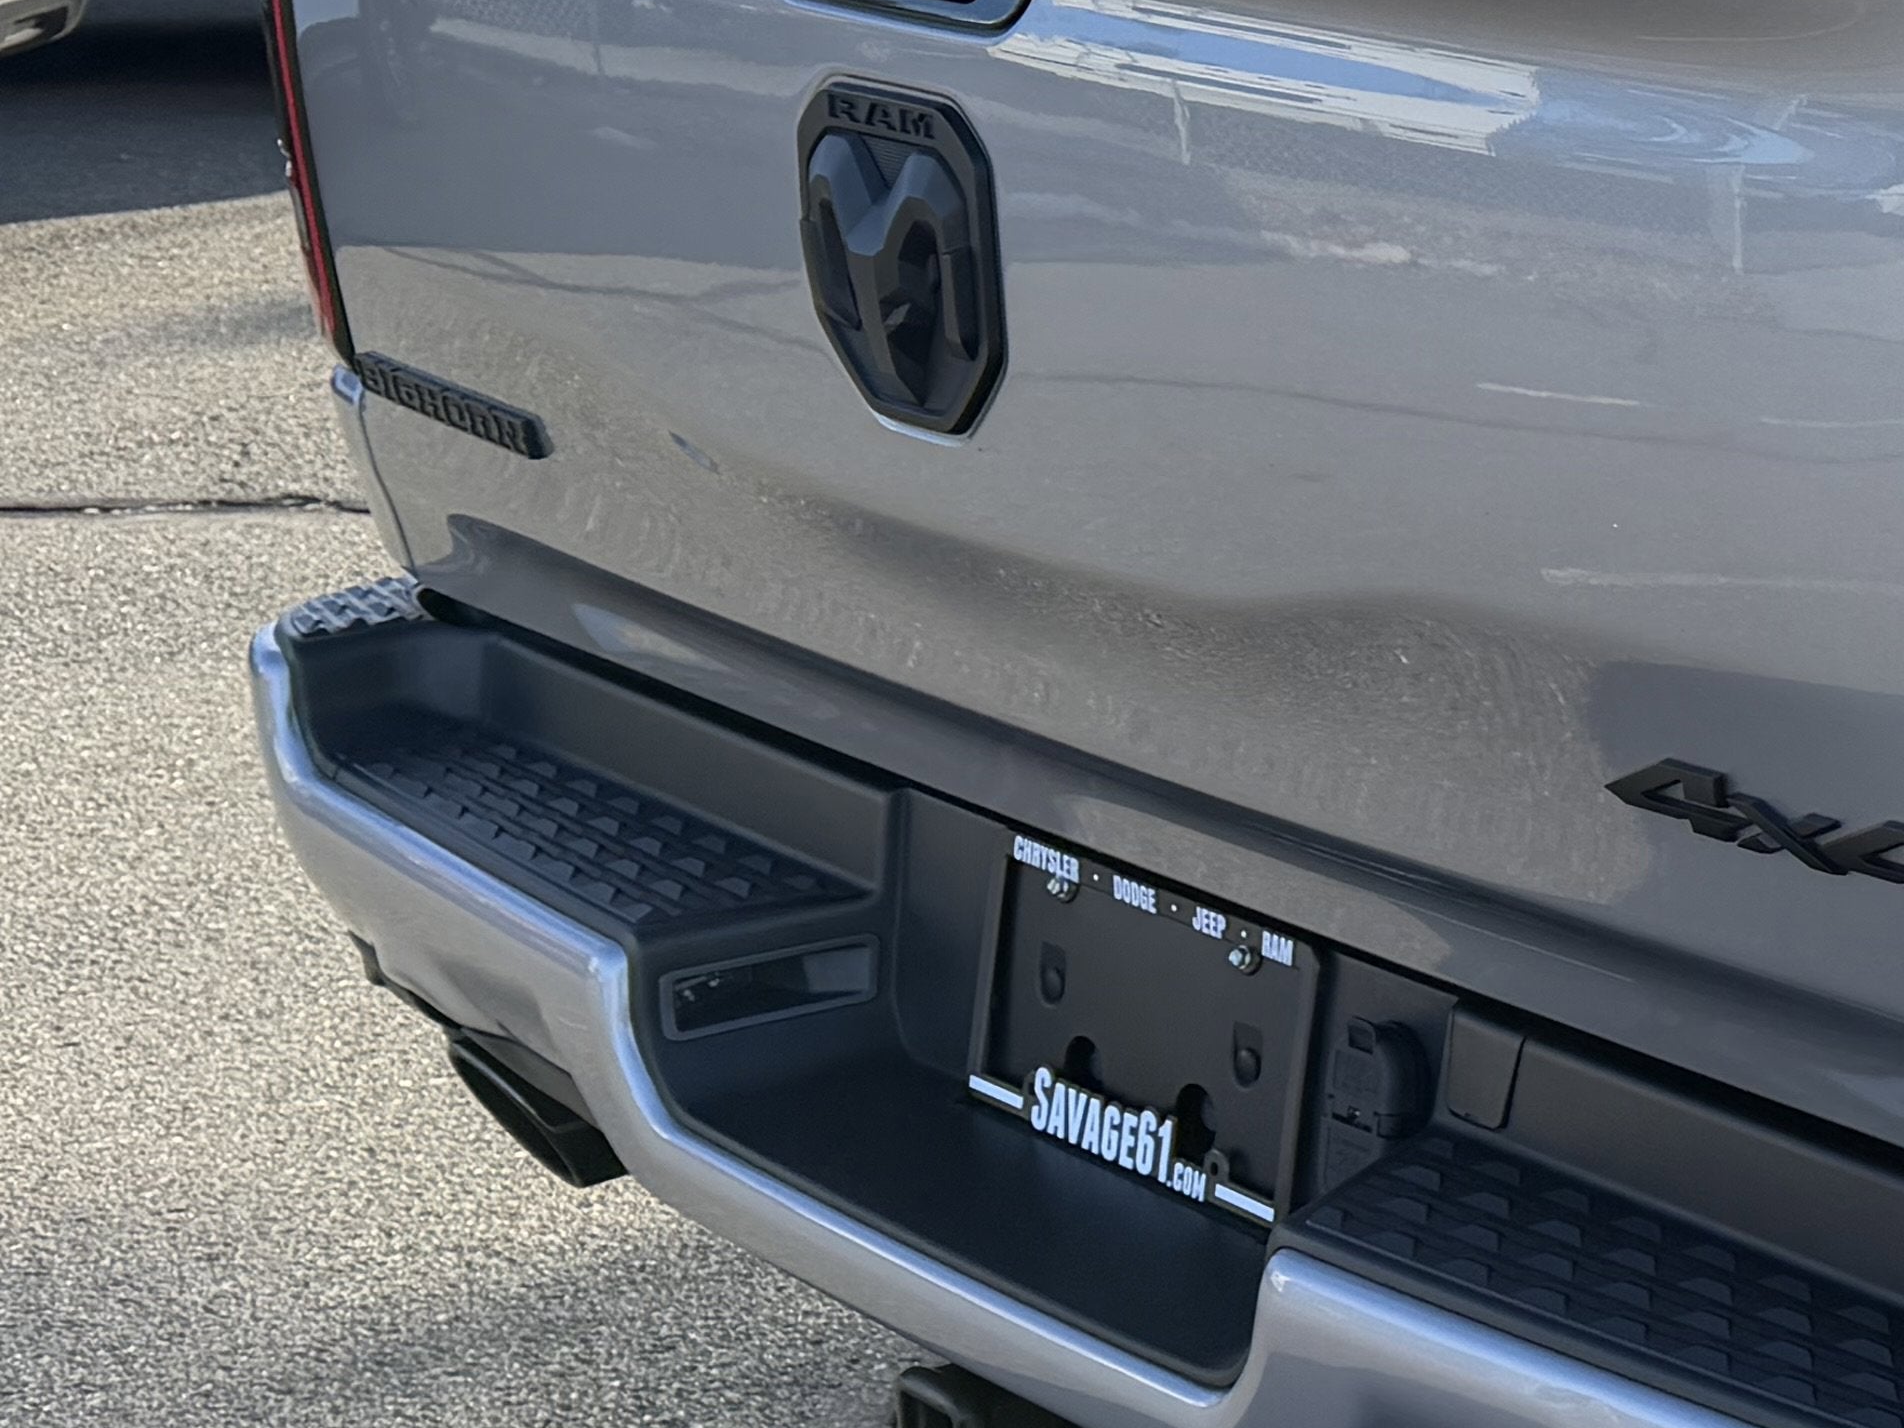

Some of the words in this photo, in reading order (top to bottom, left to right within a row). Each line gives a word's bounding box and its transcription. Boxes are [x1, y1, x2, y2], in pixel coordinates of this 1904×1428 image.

[826, 92, 936, 140] RAM
[1012, 834, 1080, 884] CHRYSLER
[1112, 874, 1158, 915] DODGE
[1191, 906, 1227, 940] JEEP
[1260, 930, 1295, 967] RAM
